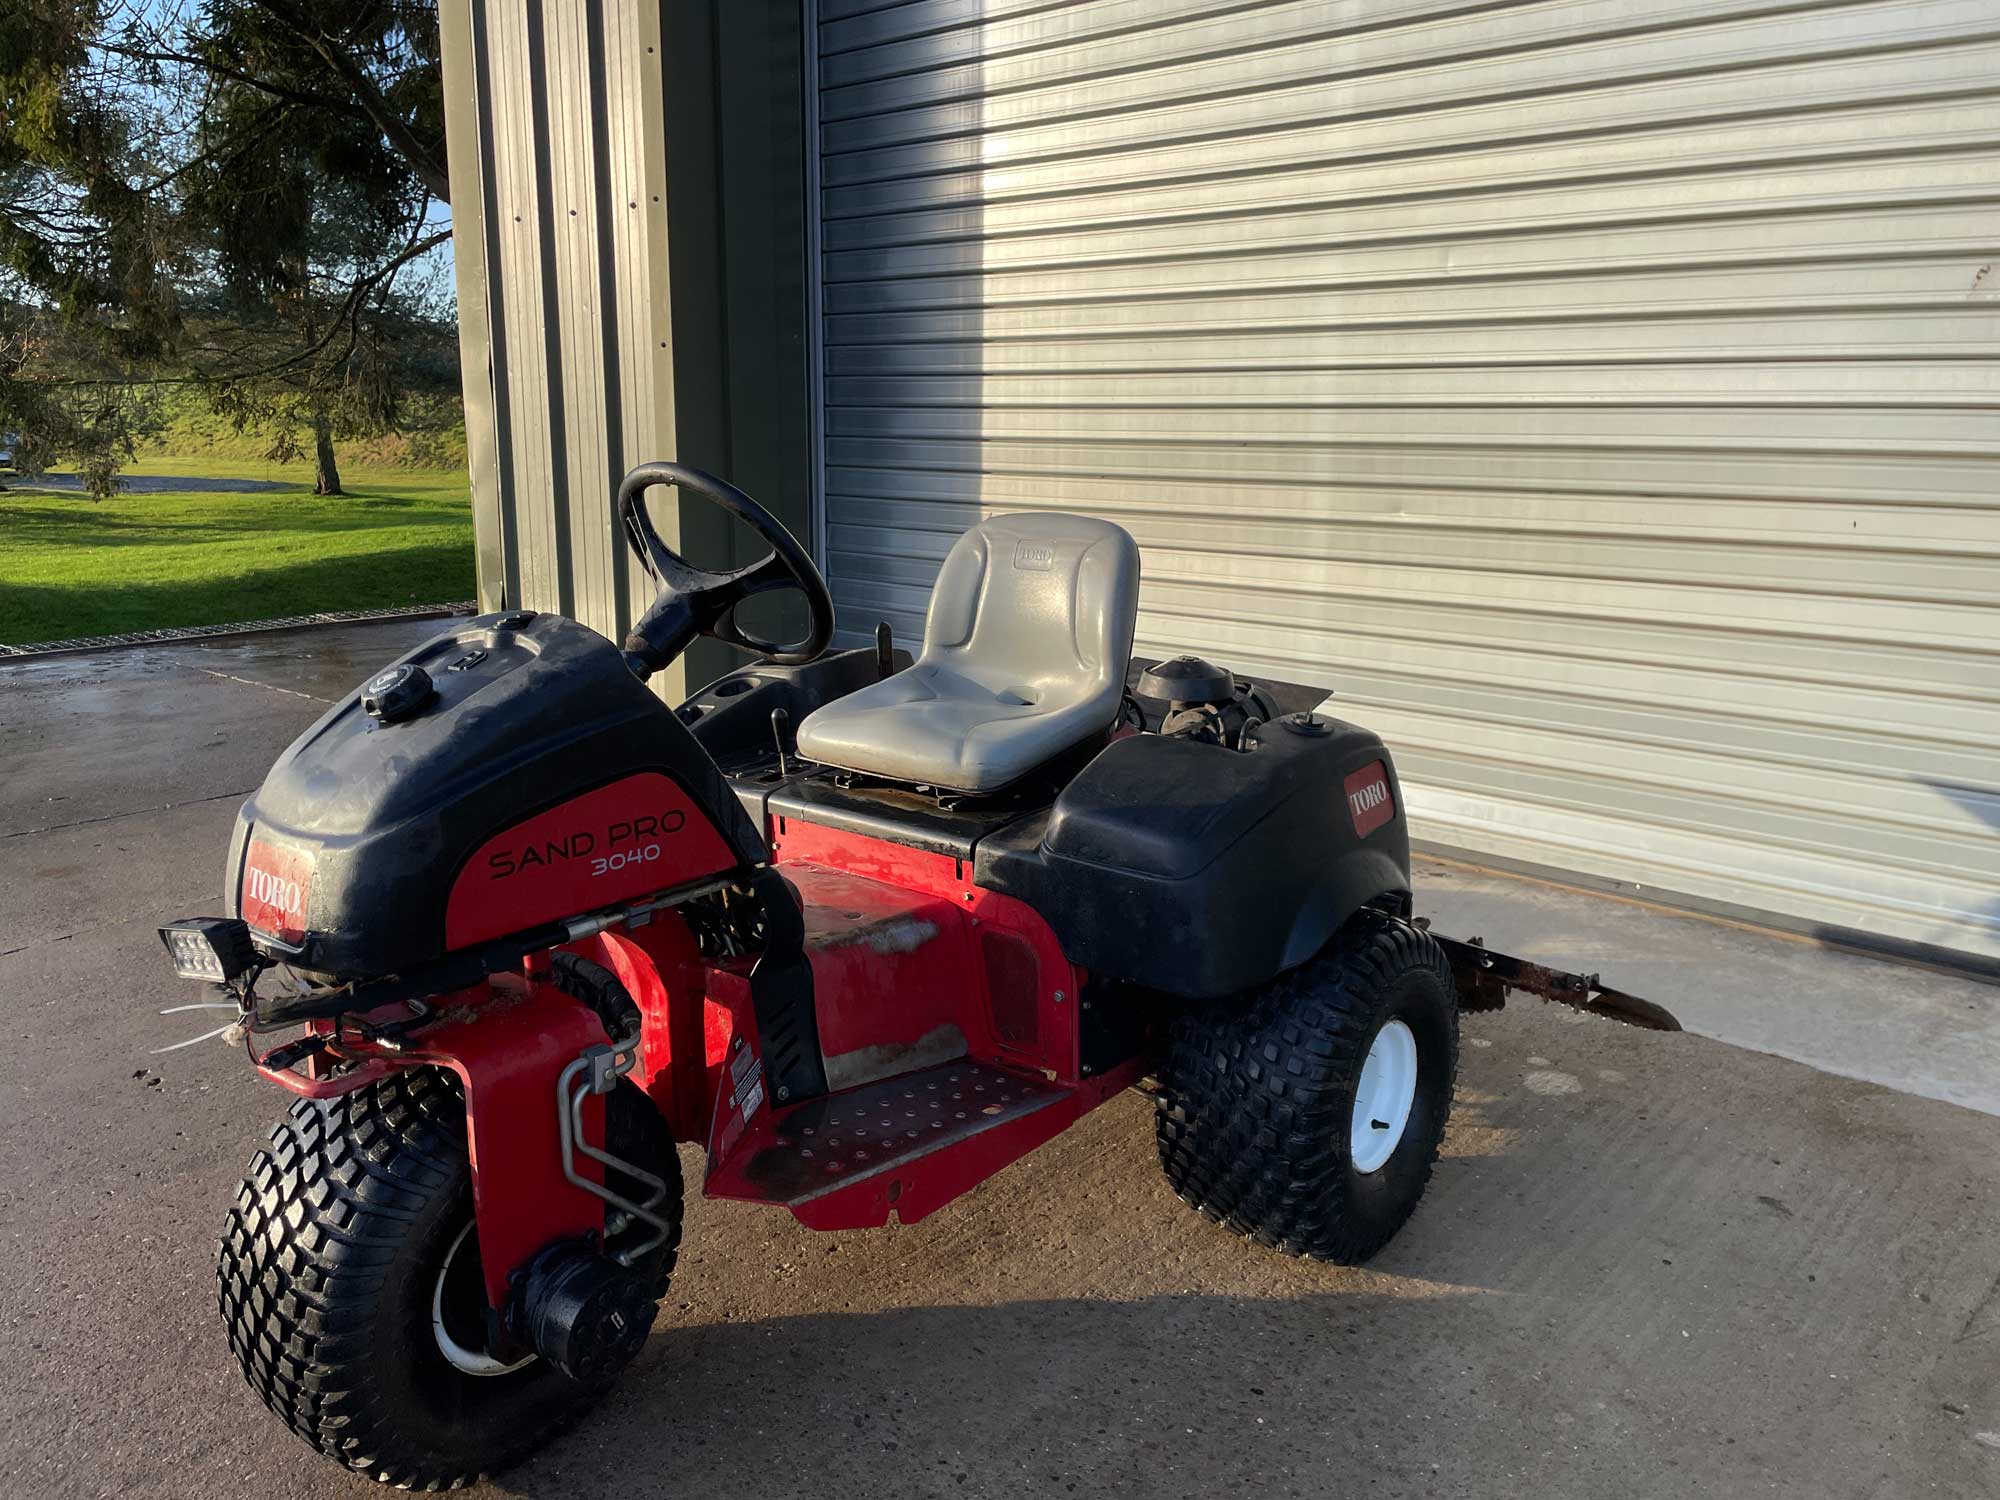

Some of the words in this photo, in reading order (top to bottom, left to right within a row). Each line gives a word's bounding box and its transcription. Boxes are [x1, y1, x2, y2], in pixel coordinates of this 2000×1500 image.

[1350, 780, 1387, 816] TORO
[488, 832, 595, 879] SAND
[608, 809, 686, 848] PRO
[591, 844, 661, 877] 3040
[249, 866, 301, 914] TORO
